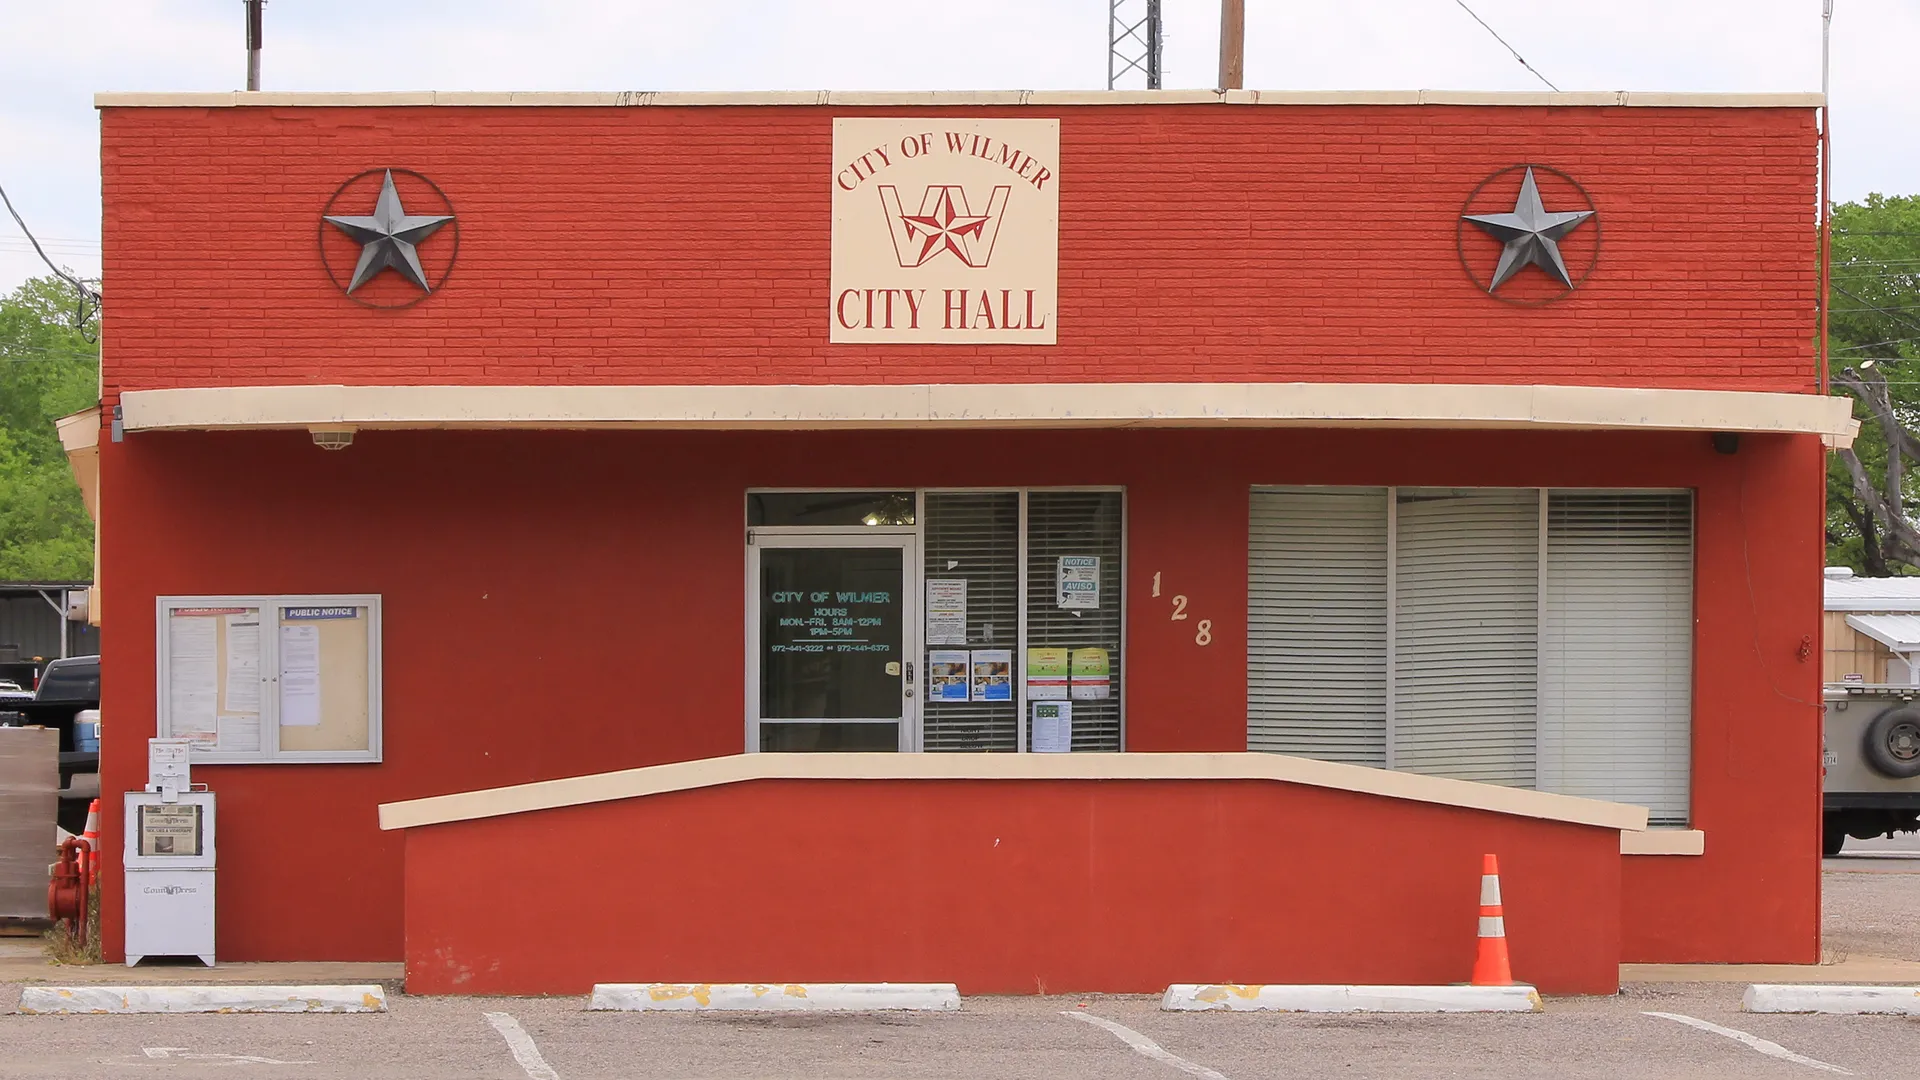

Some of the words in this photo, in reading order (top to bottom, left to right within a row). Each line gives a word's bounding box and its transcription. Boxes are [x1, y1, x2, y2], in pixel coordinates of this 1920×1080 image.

[837, 143, 892, 191] CITY
[900, 132, 934, 159] OF
[944, 131, 1051, 191] WILMER
[837, 288, 926, 330] CITY
[941, 288, 1046, 330] HALL
[1064, 558, 1094, 567] NOTICE
[1065, 582, 1093, 591] AVISO
[772, 591, 804, 604] CITY
[810, 591, 830, 604] OF
[836, 591, 890, 604] WILMER
[289, 608, 320, 617] PUBLIC
[321, 607, 352, 616] NOTICE
[813, 608, 848, 617] HOURS
[832, 618, 882, 627] 8AM-12PM
[809, 628, 853, 636] 1PM-5PM
